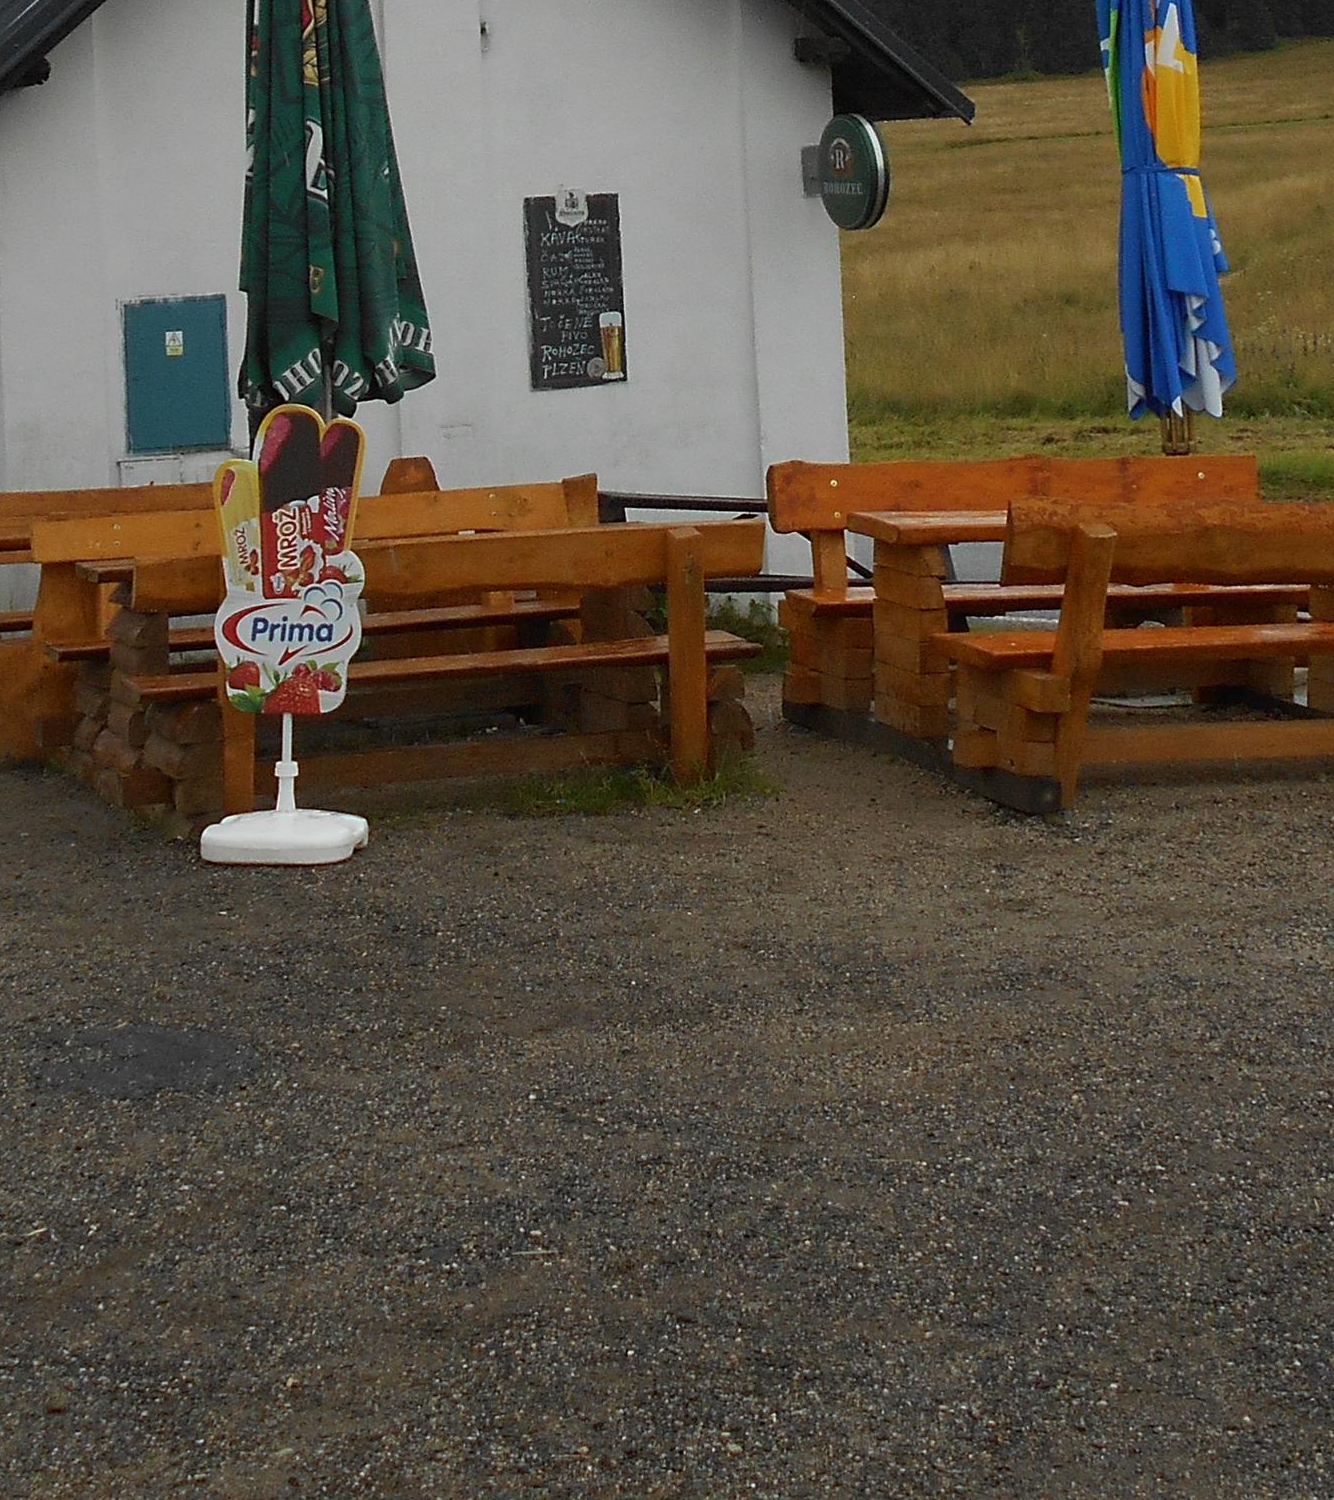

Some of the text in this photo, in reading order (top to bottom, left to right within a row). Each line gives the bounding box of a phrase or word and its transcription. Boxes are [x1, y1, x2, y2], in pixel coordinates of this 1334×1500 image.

[540, 344, 596, 362] ROHOZEC
[272, 508, 299, 570] MROŽ
[250, 615, 334, 643] Prima
